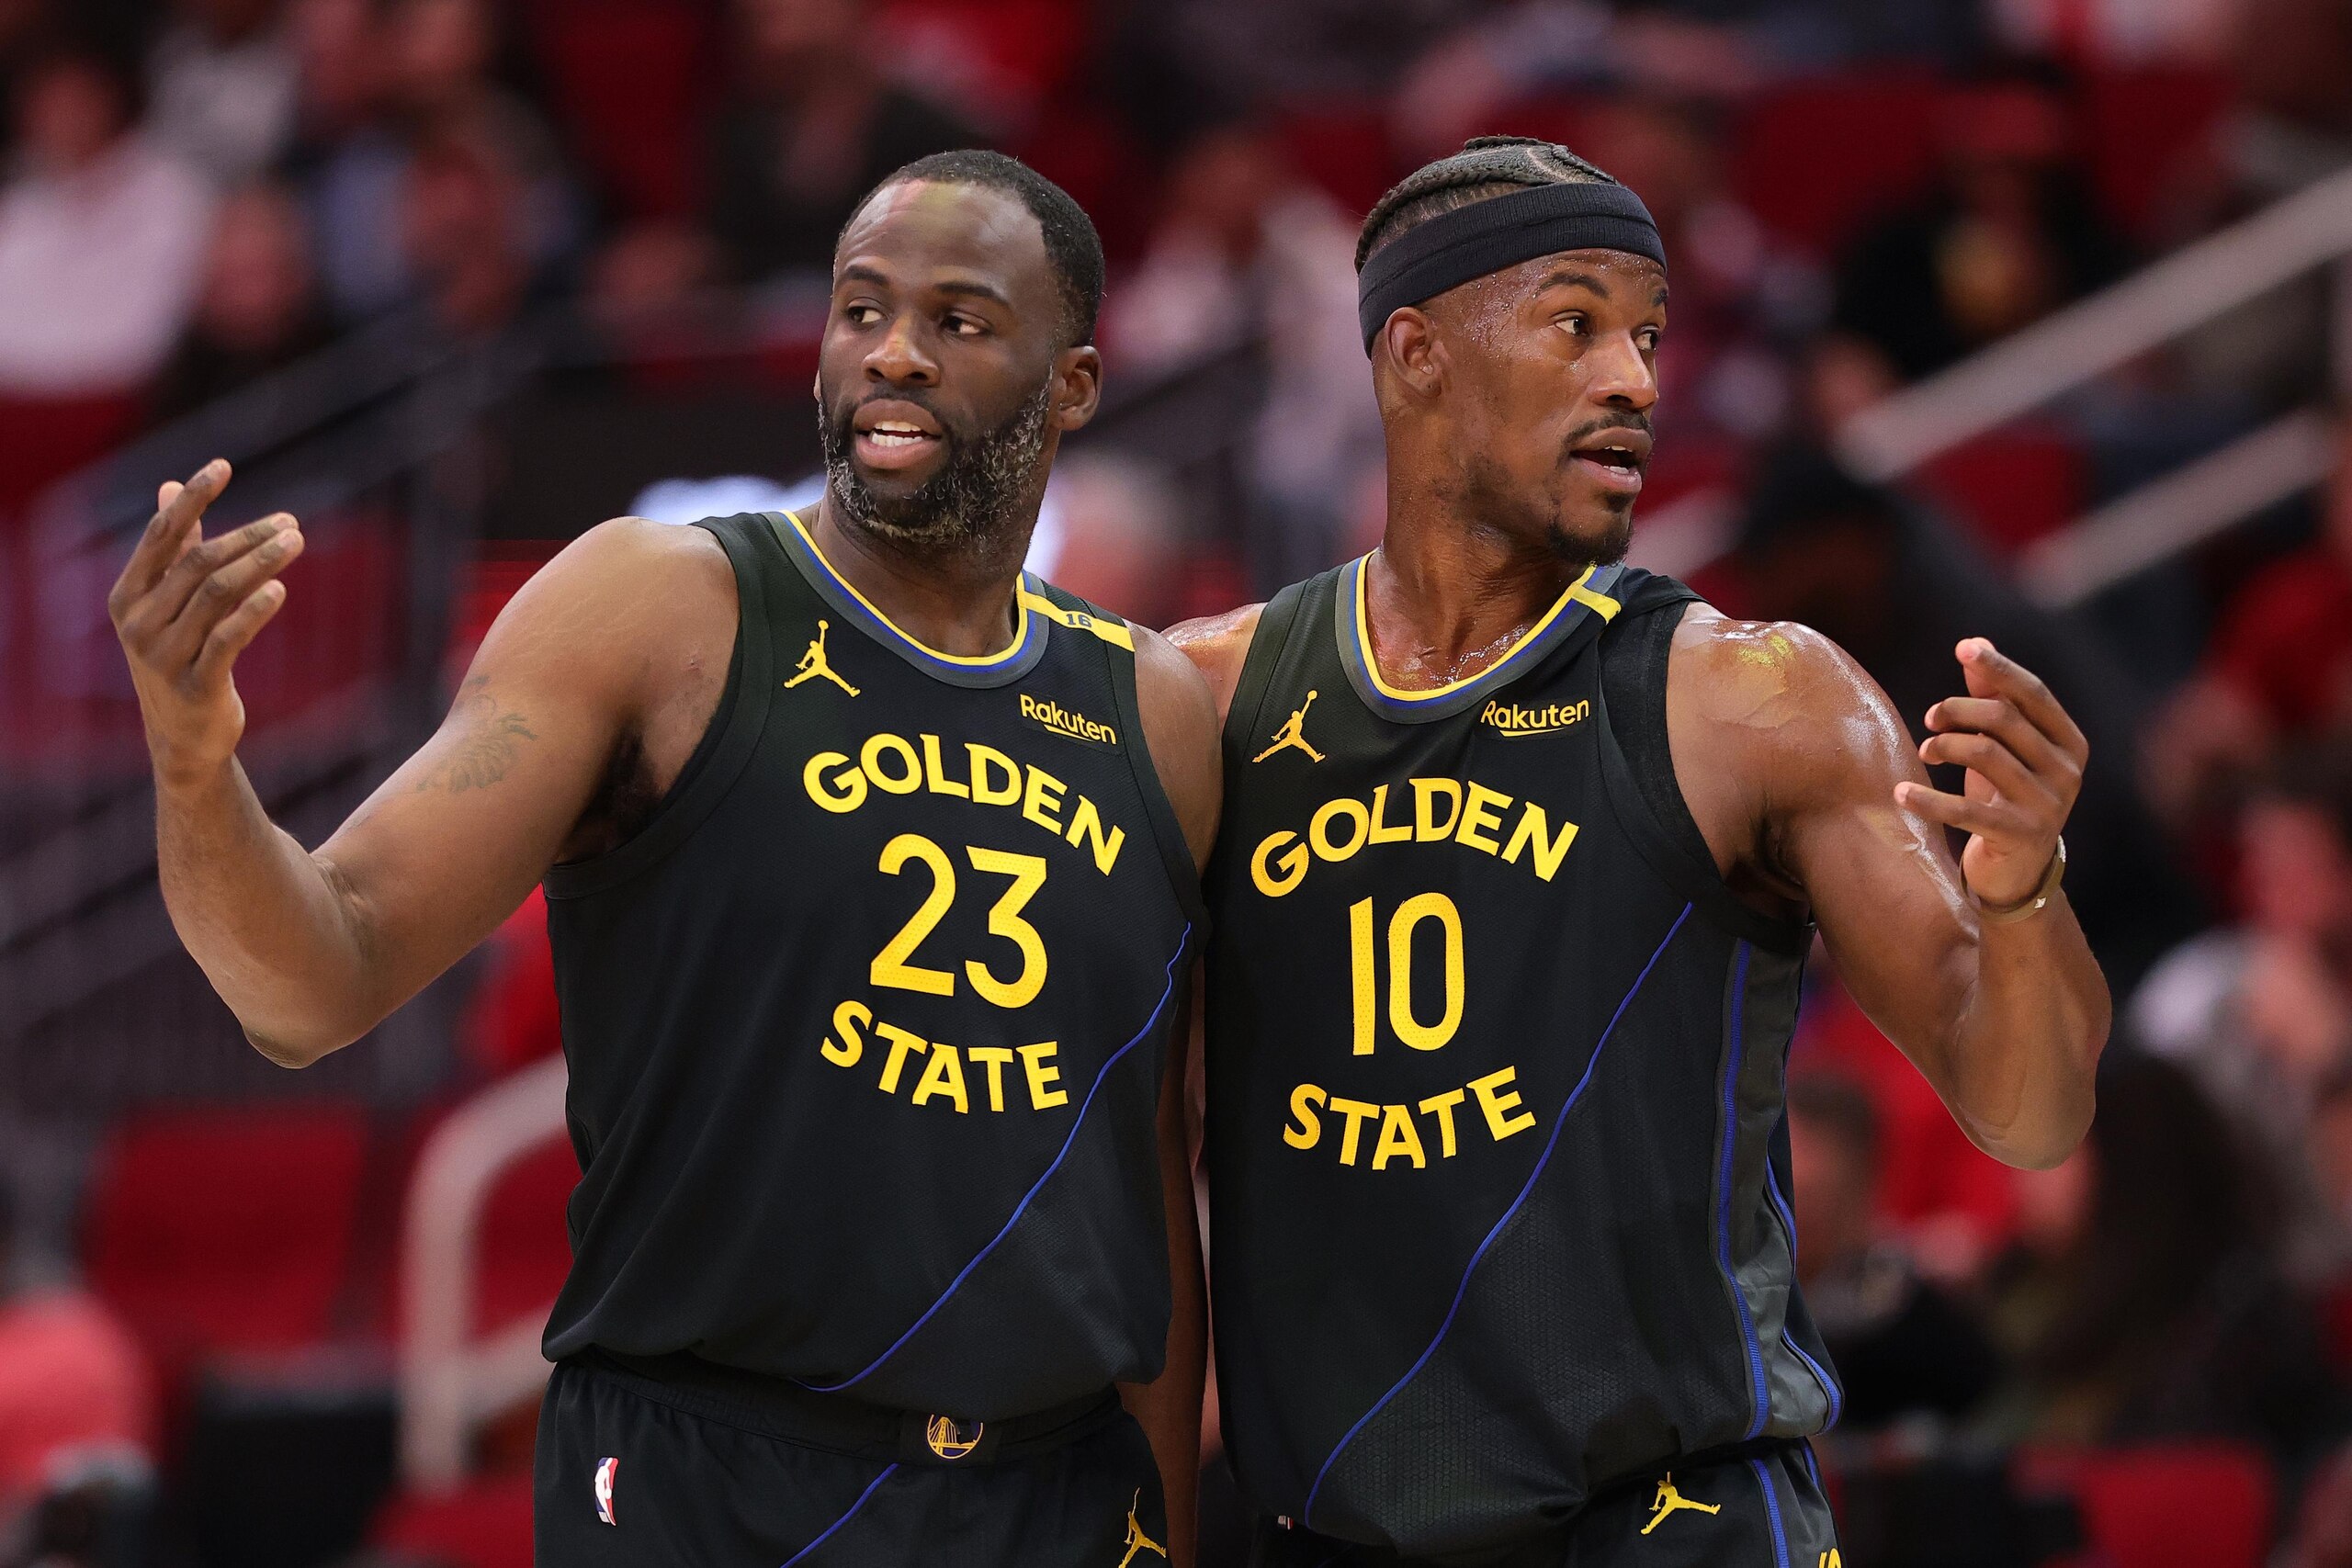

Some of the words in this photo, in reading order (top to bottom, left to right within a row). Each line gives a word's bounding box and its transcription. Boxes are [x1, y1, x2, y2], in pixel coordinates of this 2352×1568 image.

[1066, 613, 1092, 628] 16
[1019, 694, 1116, 746] Rakuten
[1480, 699, 1590, 737] Rakuten
[803, 733, 1125, 876] GOLDEN
[1250, 777, 1579, 897] GOLDEN
[870, 833, 1048, 1010] 23
[1350, 892, 1465, 1056] 10
[820, 1000, 1069, 1114] STATE
[1283, 1066, 1537, 1170] STATE
